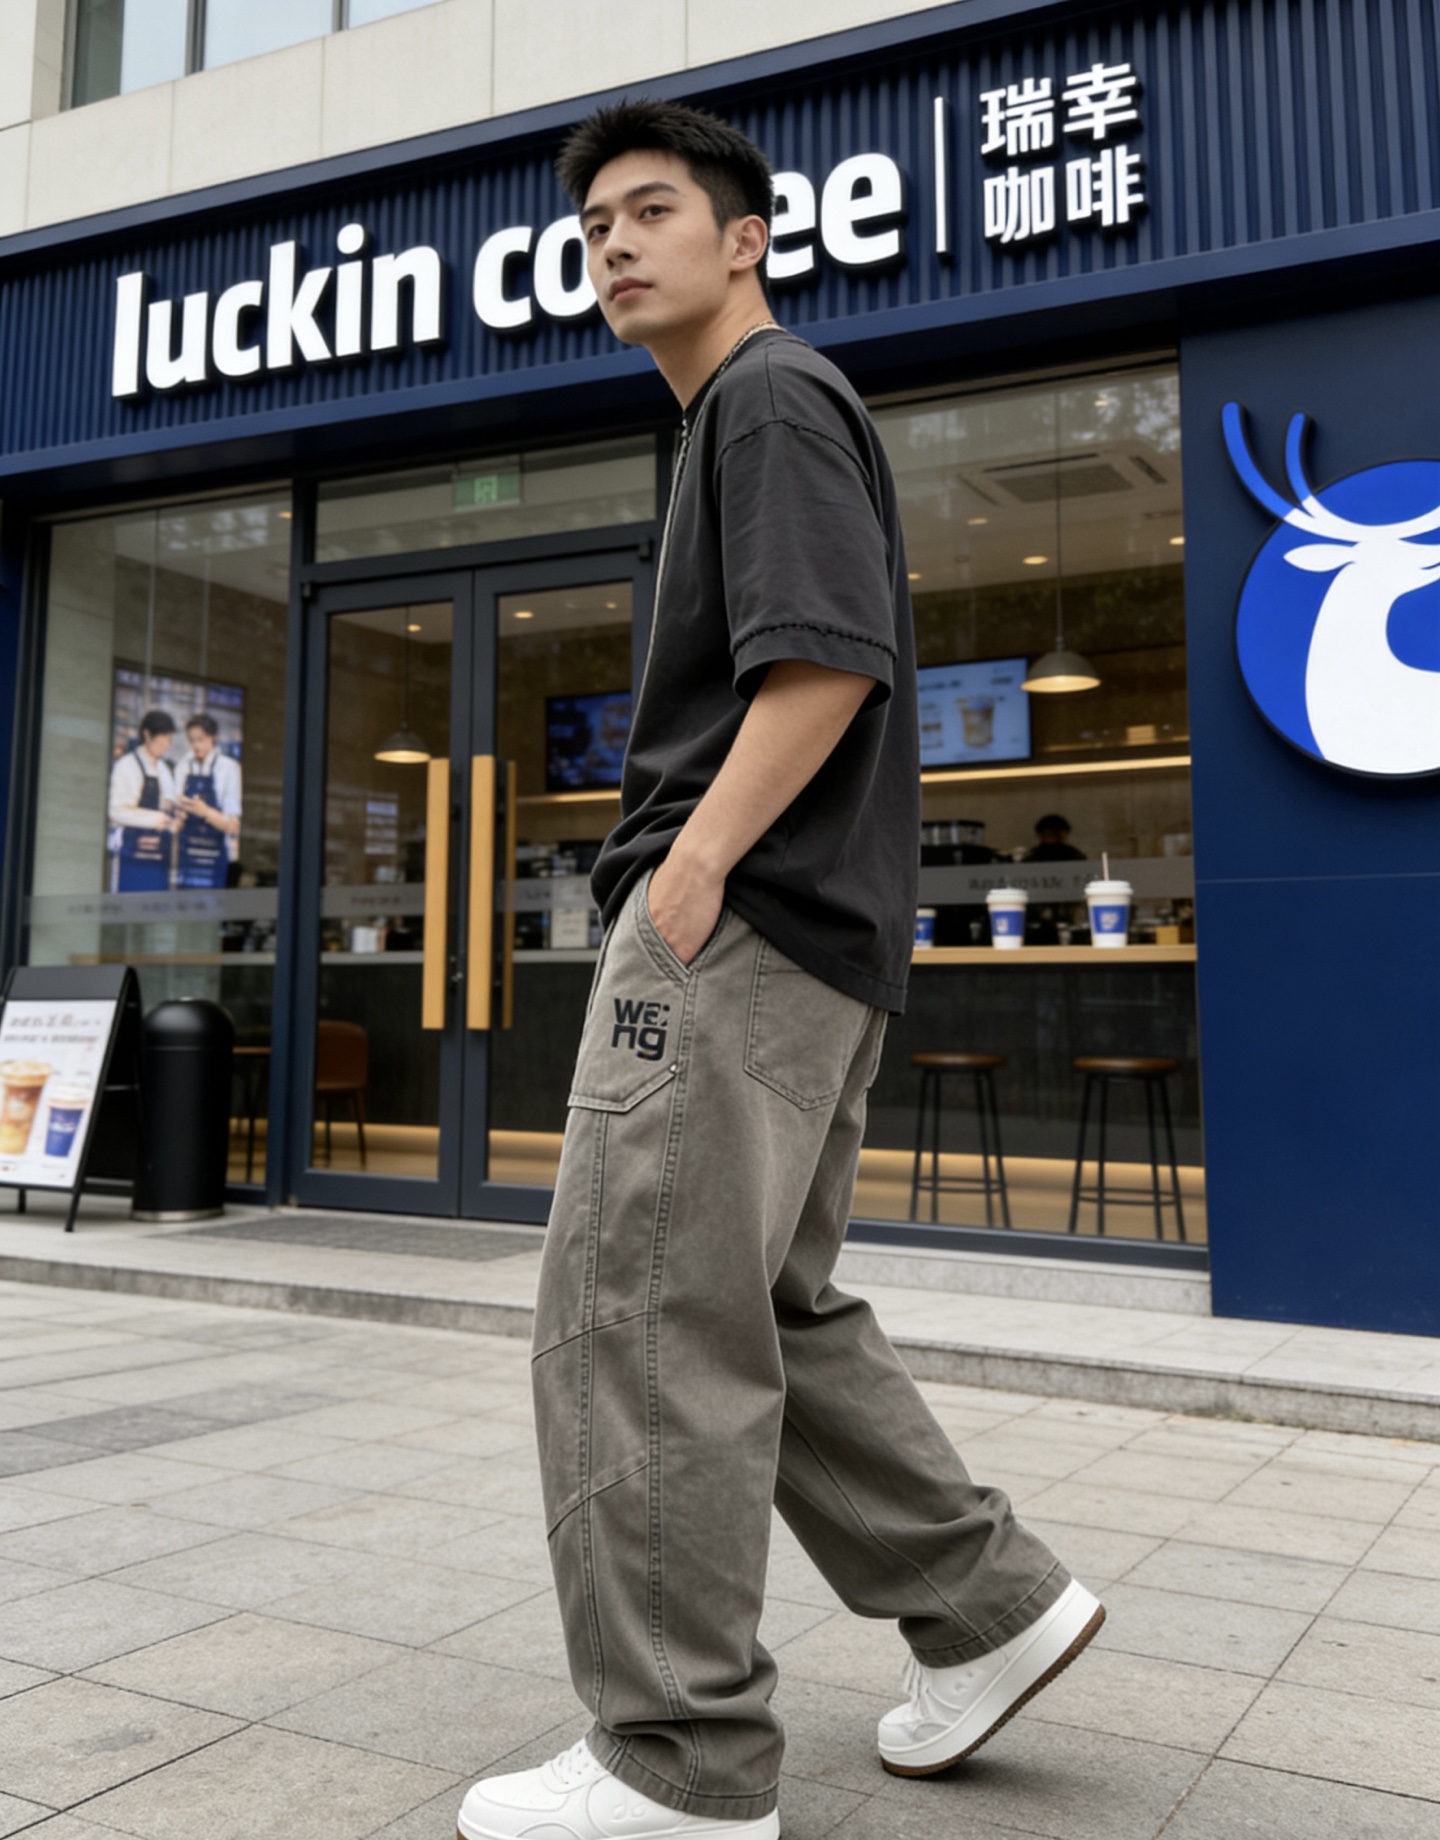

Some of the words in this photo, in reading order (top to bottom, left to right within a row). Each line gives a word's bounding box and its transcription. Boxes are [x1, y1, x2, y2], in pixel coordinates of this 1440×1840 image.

[979, 63, 1137, 156] 瑞幸
[984, 145, 1144, 244] 咖啡
[112, 223, 441, 397] luckin
[474, 152, 902, 329] coee
[611, 1024, 667, 1061] ng
